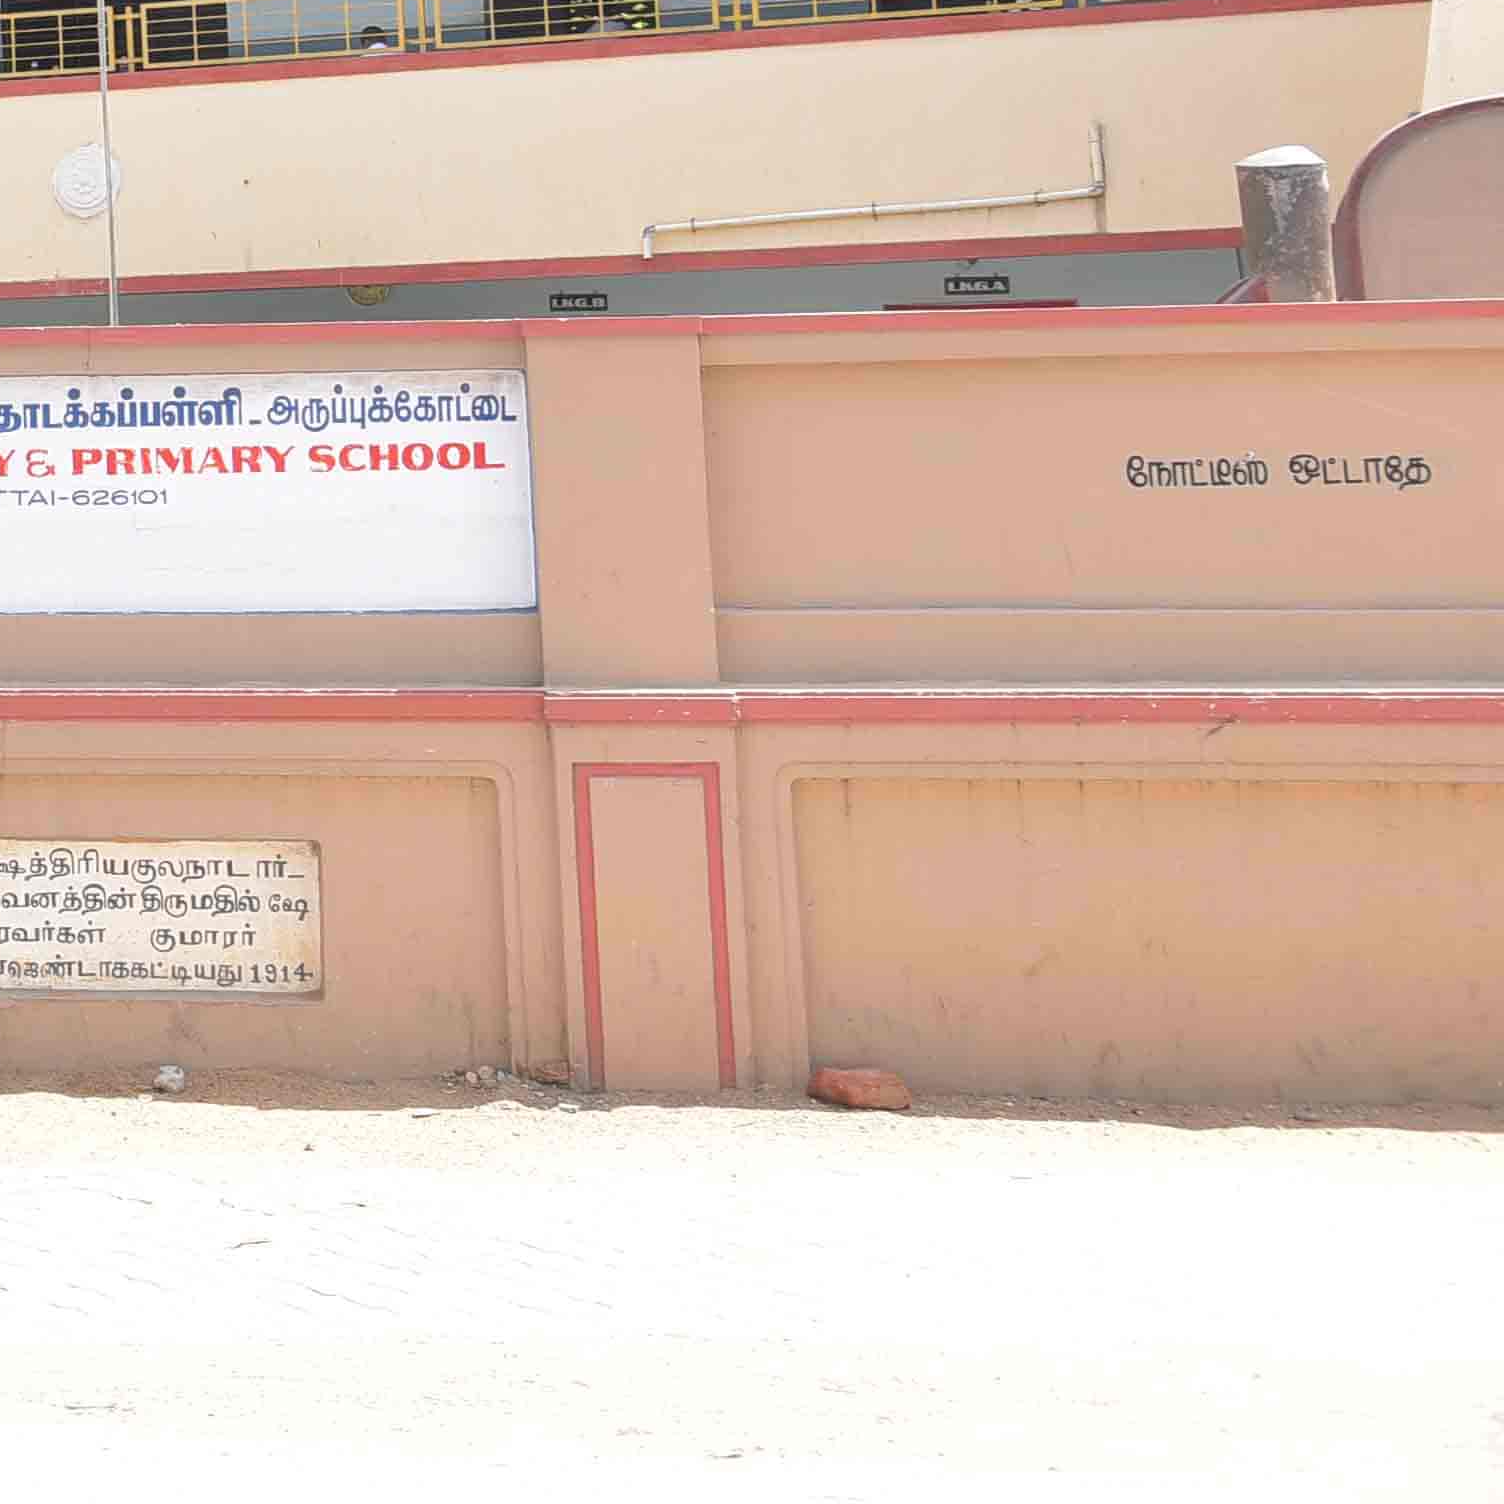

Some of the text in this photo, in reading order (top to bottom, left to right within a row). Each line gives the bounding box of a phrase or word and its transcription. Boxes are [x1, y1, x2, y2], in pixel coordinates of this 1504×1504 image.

[25, 448, 57, 479] &
[70, 445, 295, 476] PRIMARY
[307, 441, 506, 473] SCHOOL
